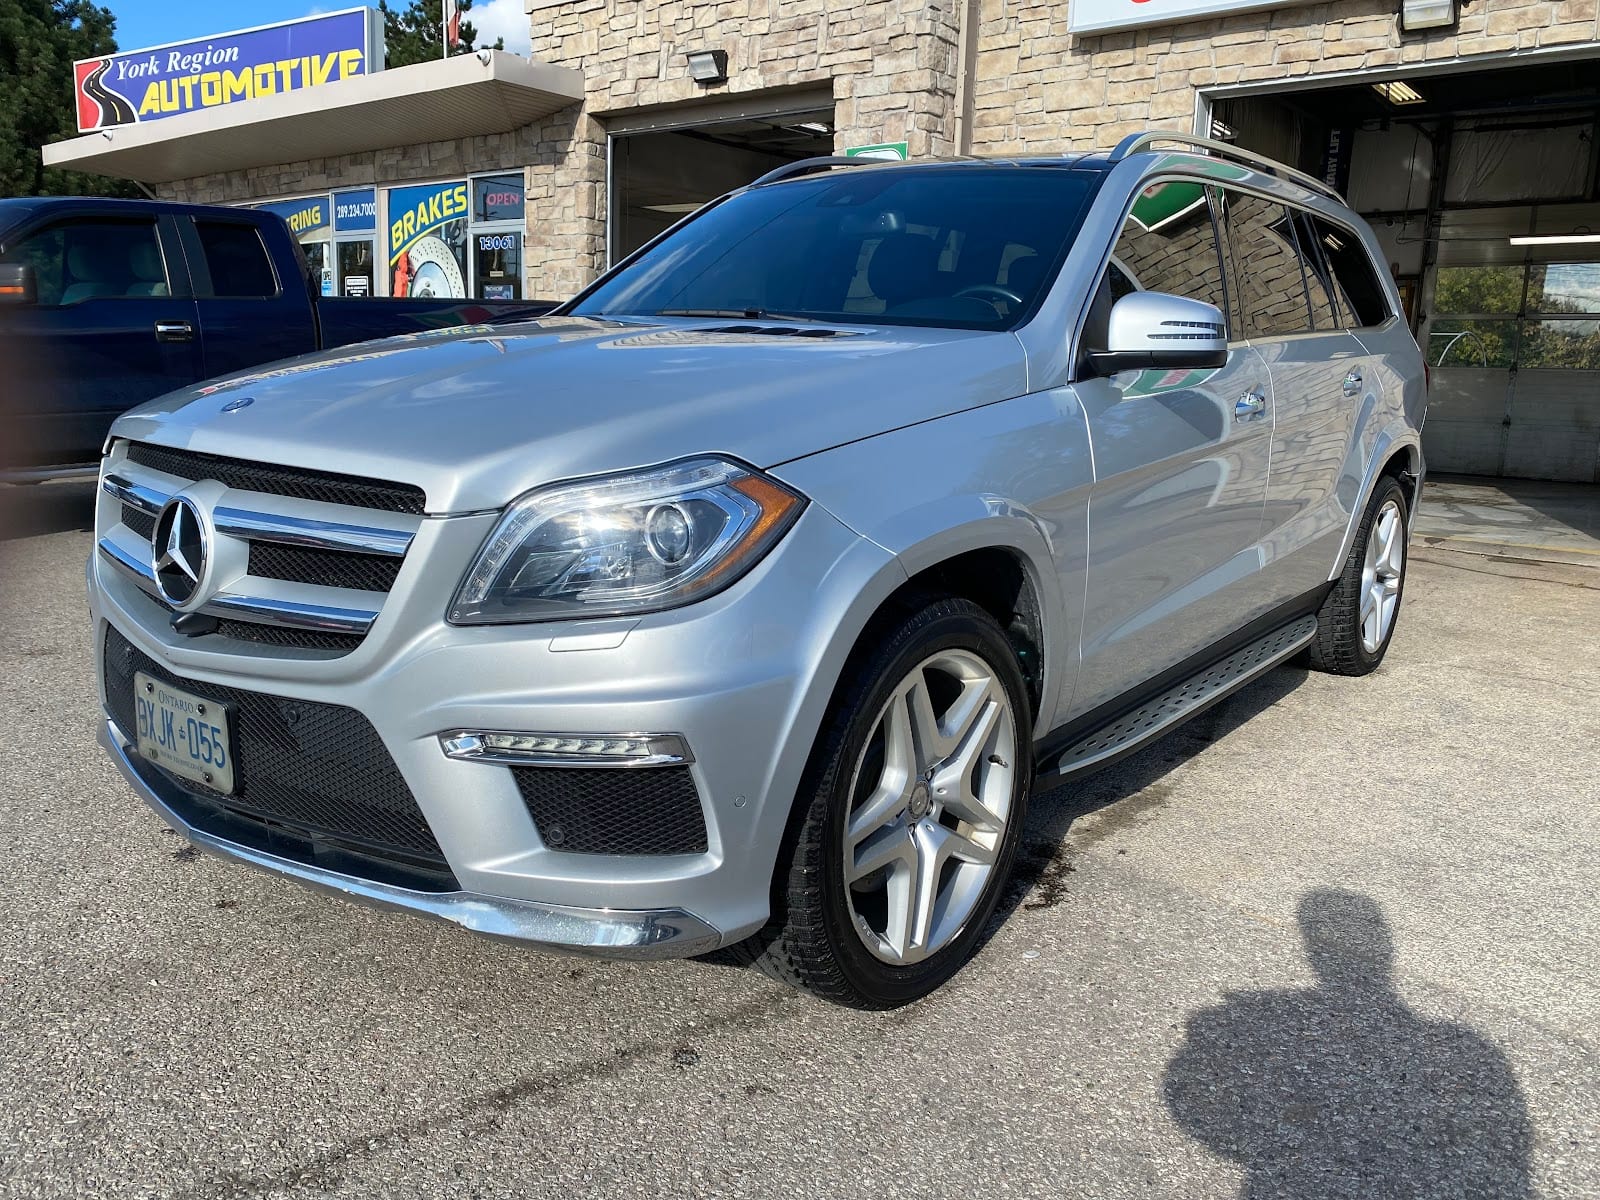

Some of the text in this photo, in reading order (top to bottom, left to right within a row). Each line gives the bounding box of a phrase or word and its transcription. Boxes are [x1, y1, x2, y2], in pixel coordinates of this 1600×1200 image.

[117, 46, 239, 80] York Region
[139, 49, 363, 115] AUTOMOTIVE
[1329, 129, 1341, 153] LIFT
[487, 193, 520, 206] OPEN
[286, 206, 321, 231] RING
[391, 185, 467, 252] BRAKES
[479, 236, 514, 250] 13061
[187, 717, 226, 768] 055
